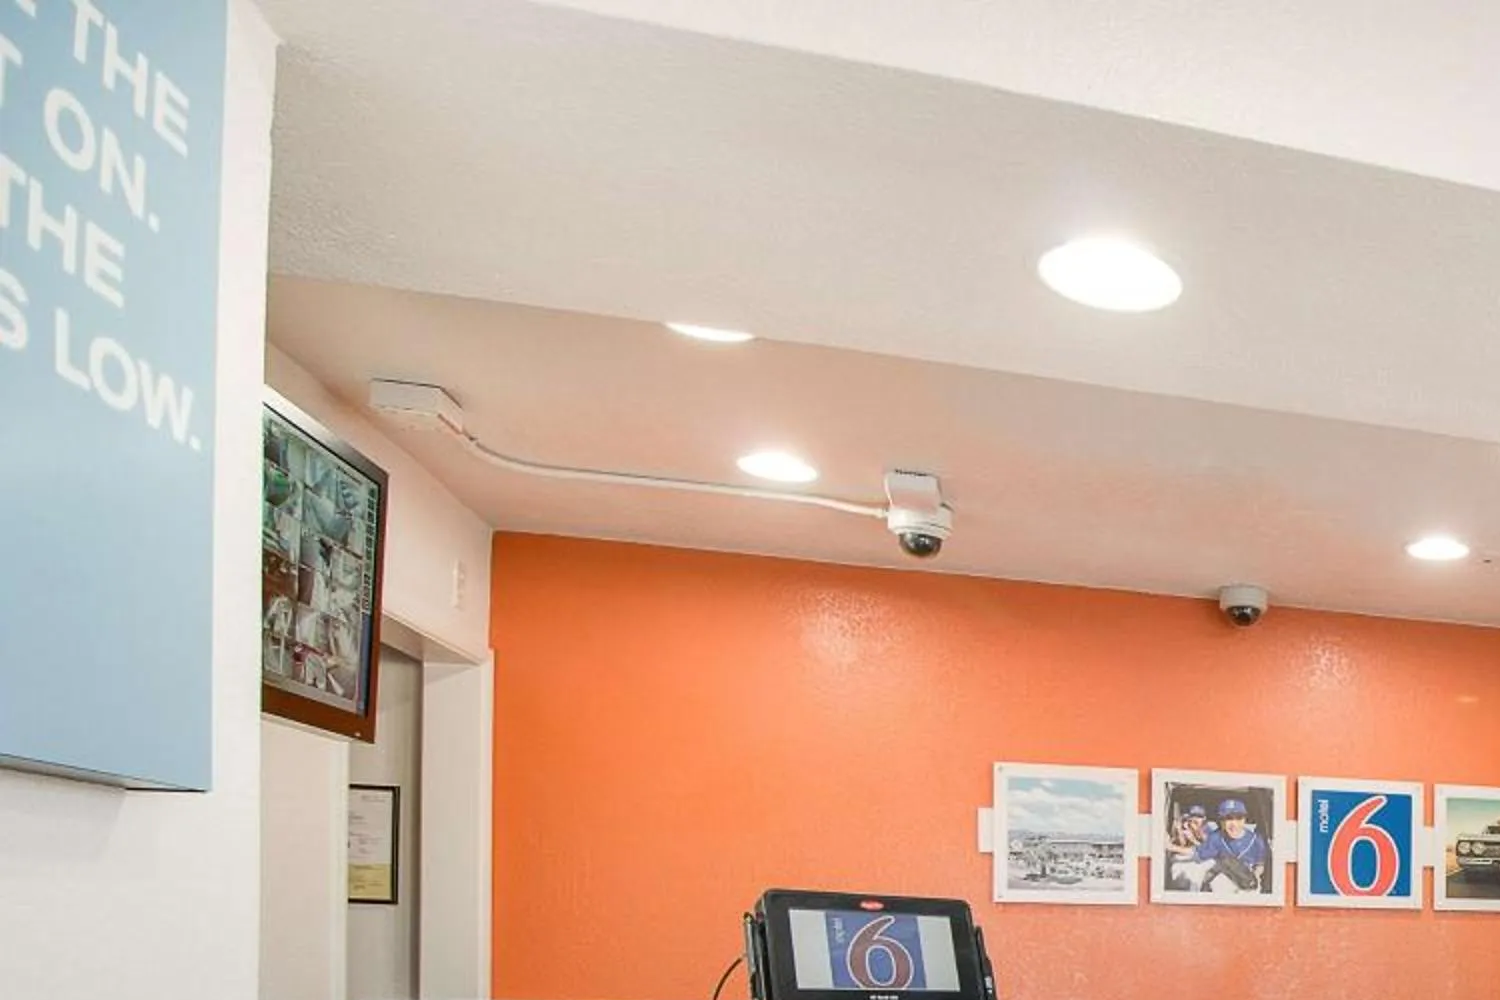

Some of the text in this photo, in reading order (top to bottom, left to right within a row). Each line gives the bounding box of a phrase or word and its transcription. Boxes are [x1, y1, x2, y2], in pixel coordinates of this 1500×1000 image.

[71, 0, 190, 159] THE
[43, 86, 160, 235] ON.
[54, 305, 201, 452] LOW.
[1327, 795, 1400, 897] 6
